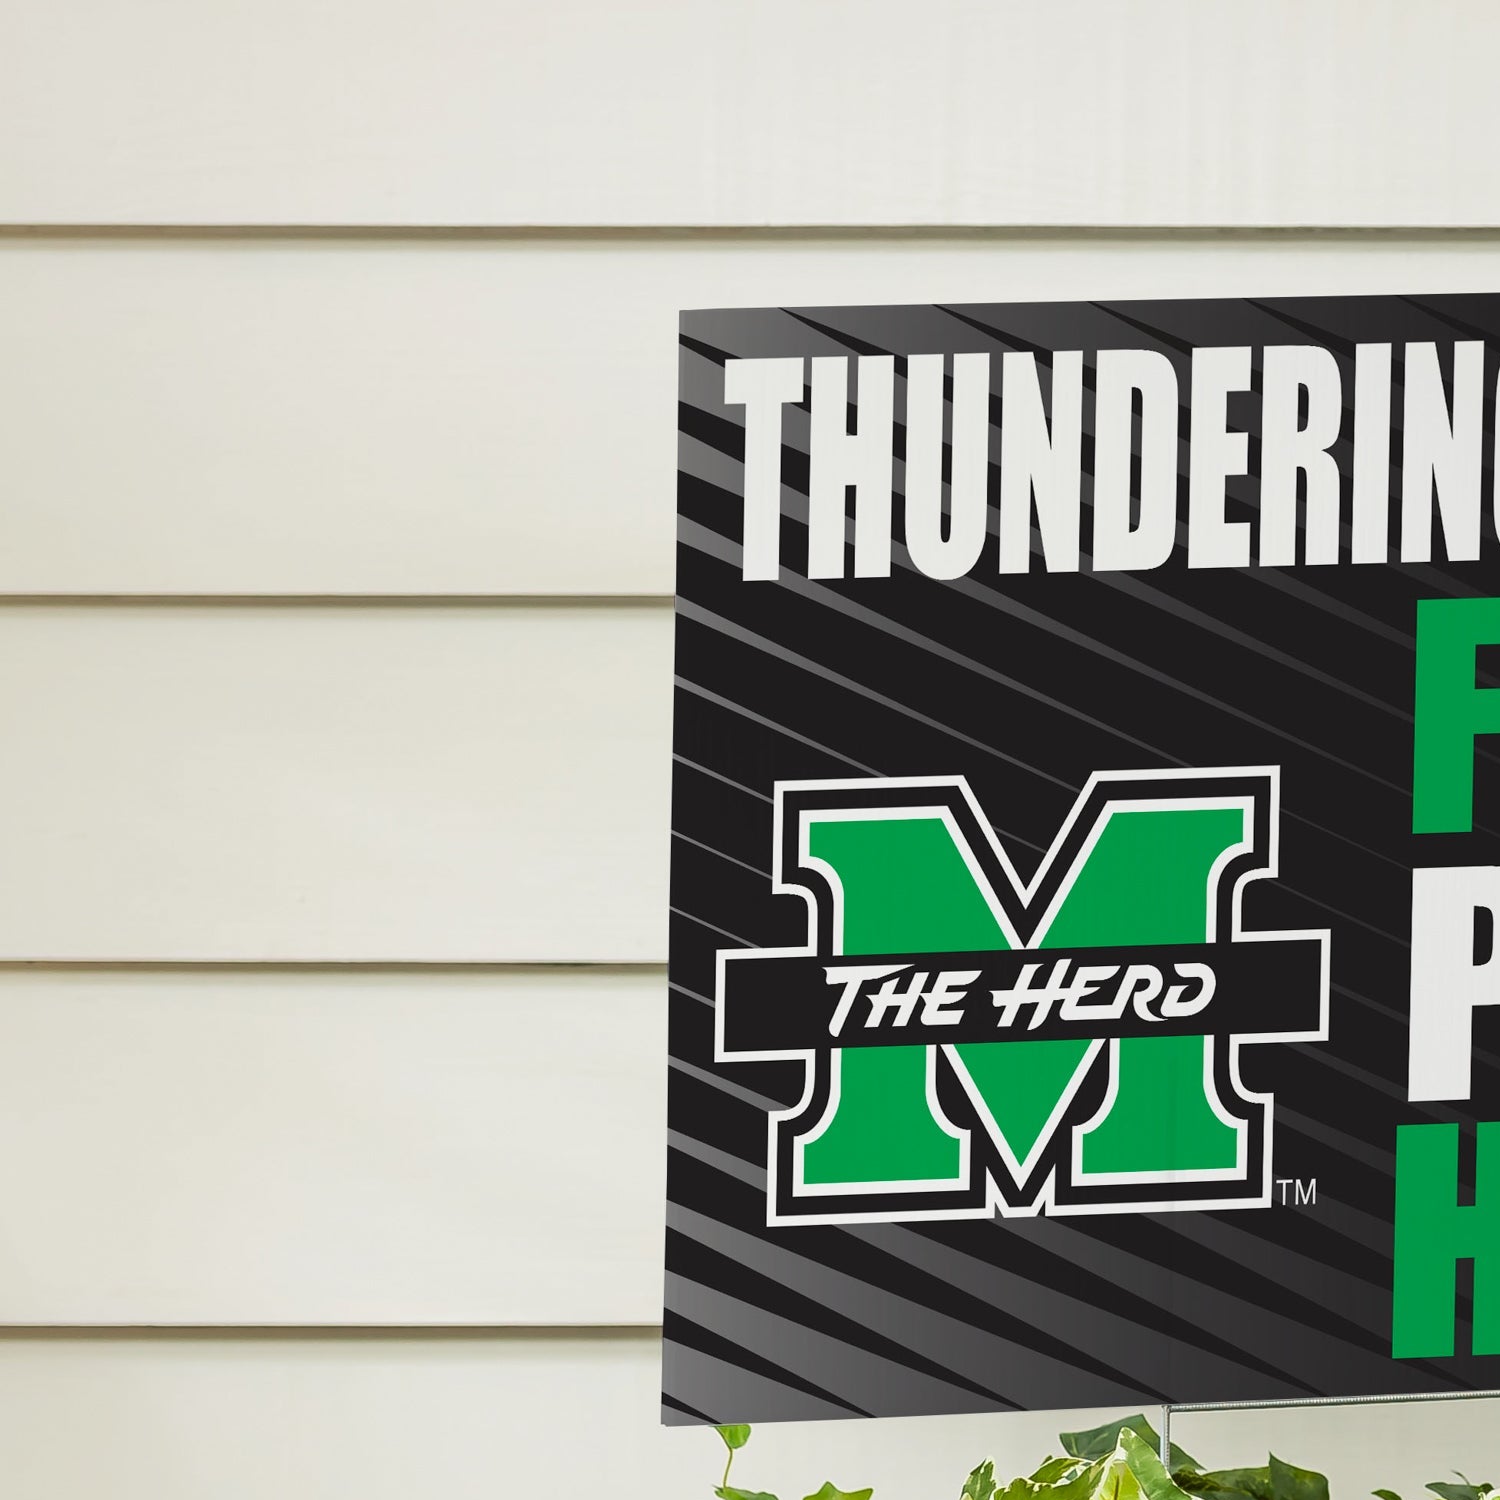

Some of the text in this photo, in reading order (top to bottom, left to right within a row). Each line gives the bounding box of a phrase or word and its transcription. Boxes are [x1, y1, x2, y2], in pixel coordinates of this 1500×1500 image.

[767, 766, 1280, 1226] M
[823, 958, 1217, 1038] THE HERD
[1276, 1178, 1317, 1206] TM
